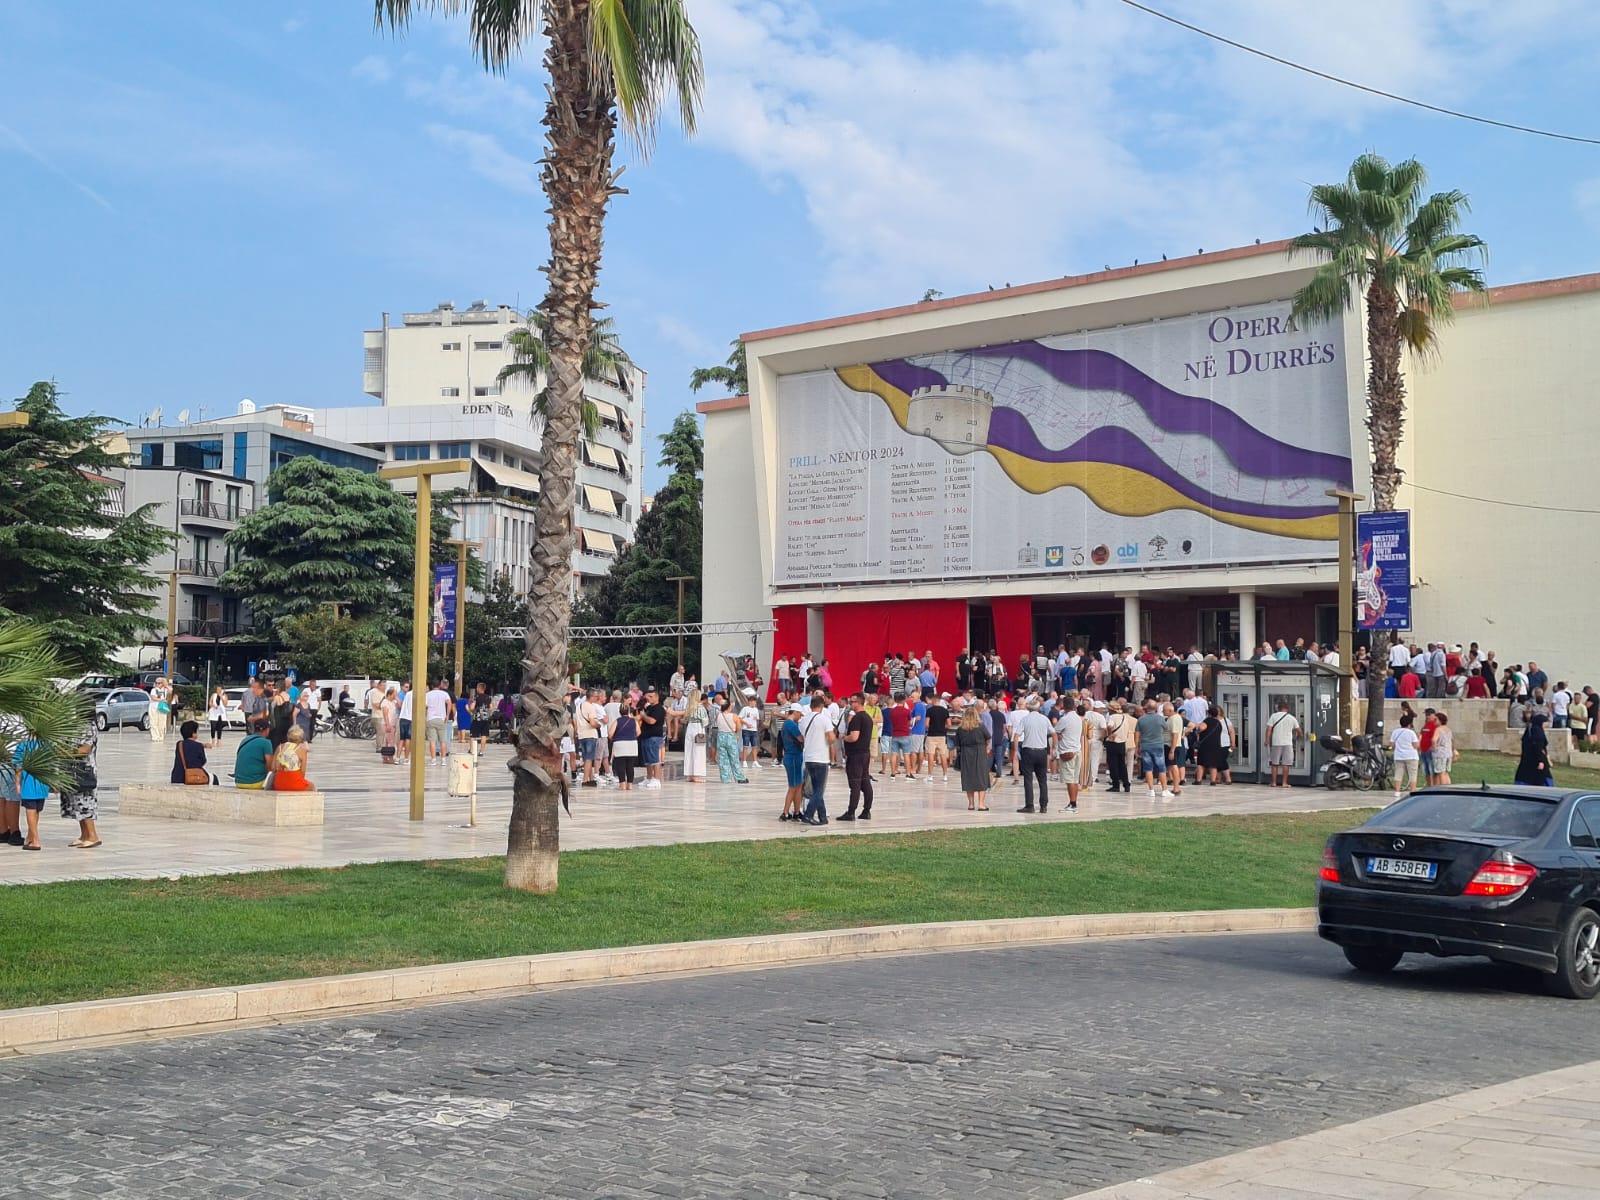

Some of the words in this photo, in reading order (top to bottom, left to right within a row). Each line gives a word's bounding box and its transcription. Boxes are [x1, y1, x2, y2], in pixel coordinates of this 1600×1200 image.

[1226, 341, 1335, 376] DURRËS
[462, 404, 493, 415] EDEN
[790, 455, 820, 468] PRILL
[880, 446, 904, 459] 2024
[1376, 859, 1389, 872] AB
